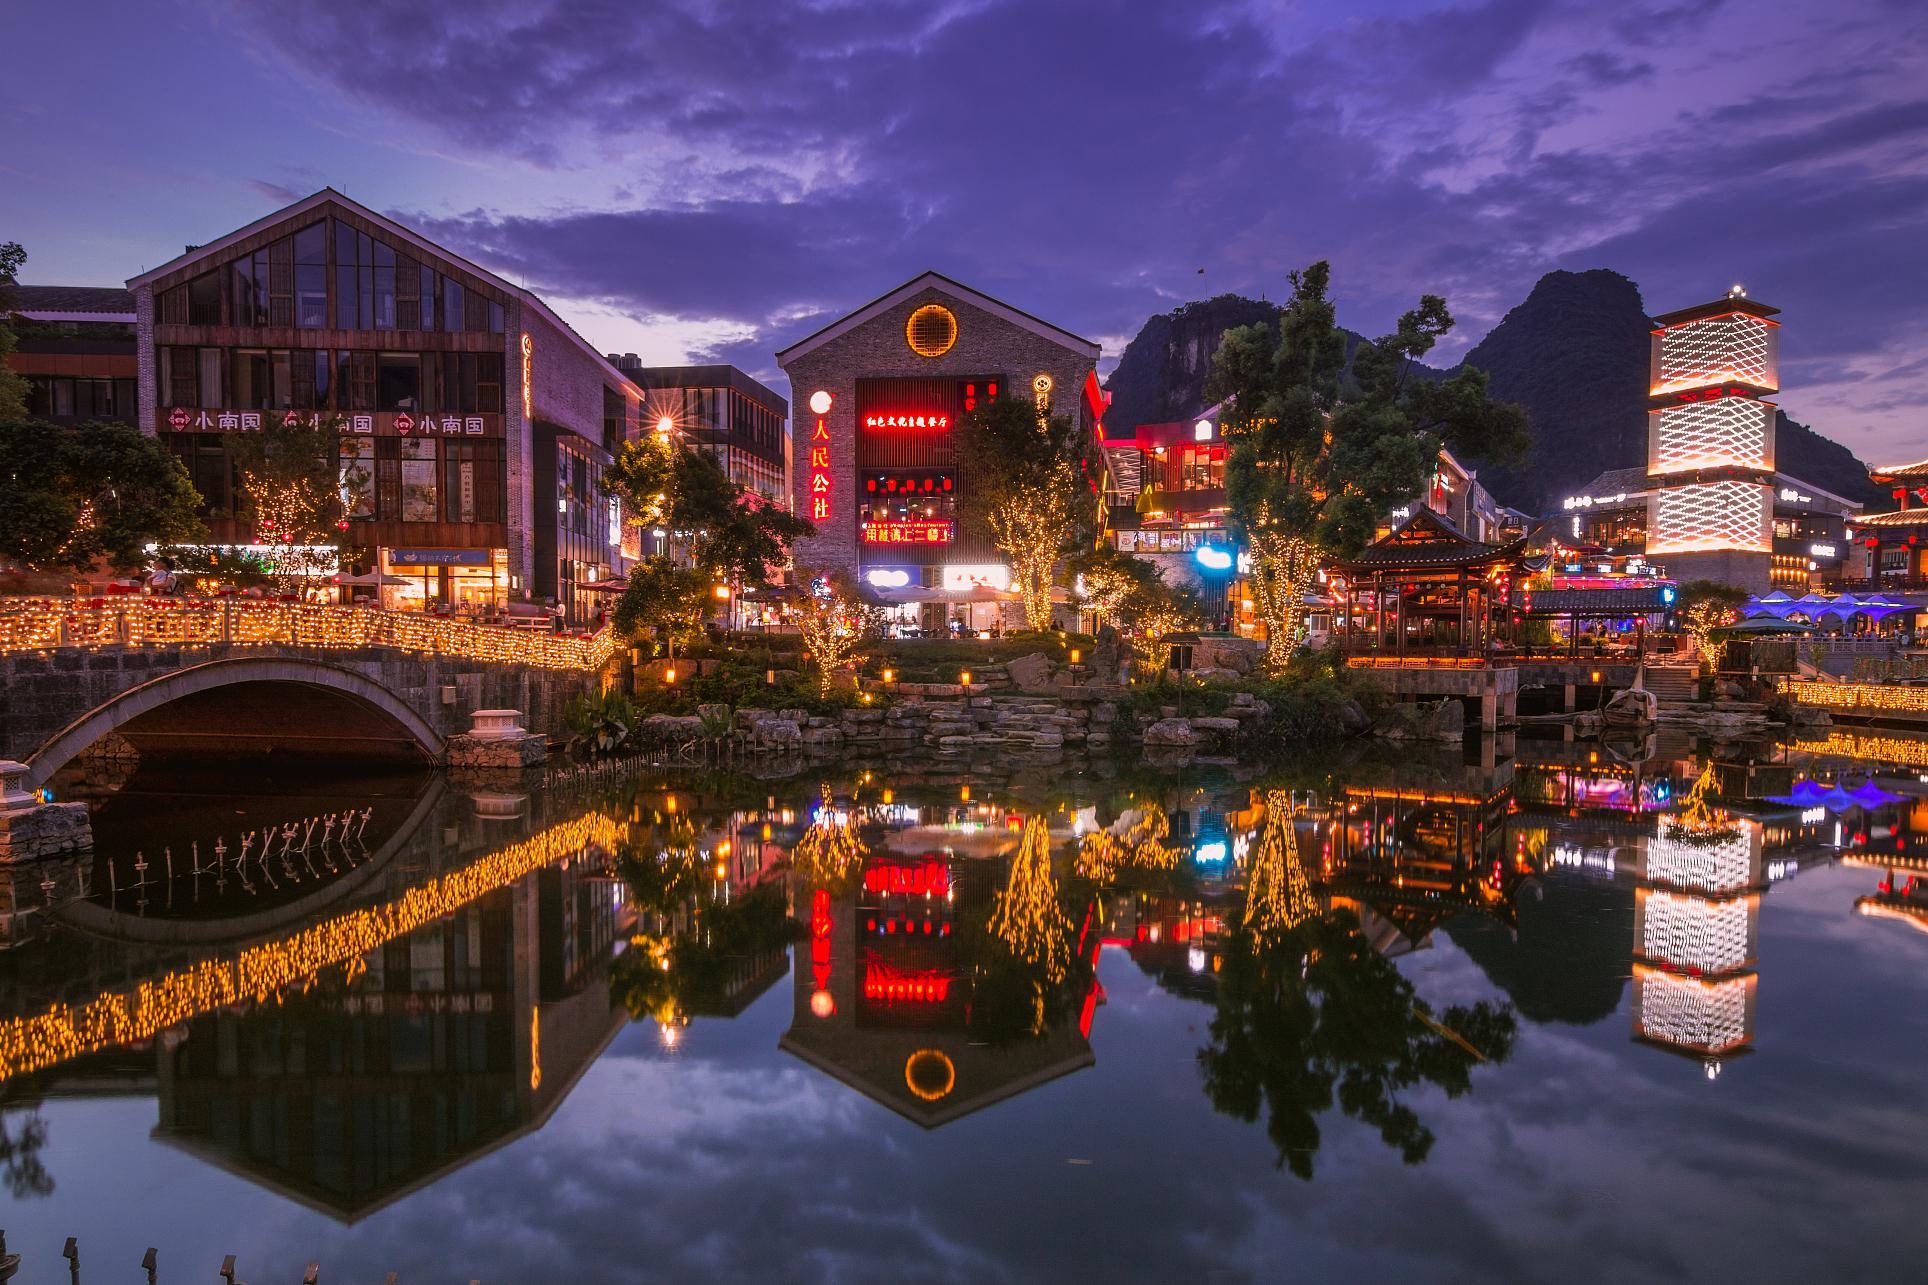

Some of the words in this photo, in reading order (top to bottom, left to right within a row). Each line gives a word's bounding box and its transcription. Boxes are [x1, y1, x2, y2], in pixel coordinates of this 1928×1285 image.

[195, 411, 260, 431] 小南国
[420, 415, 484, 435] 小南国
[812, 419, 830, 519] 人民公社
